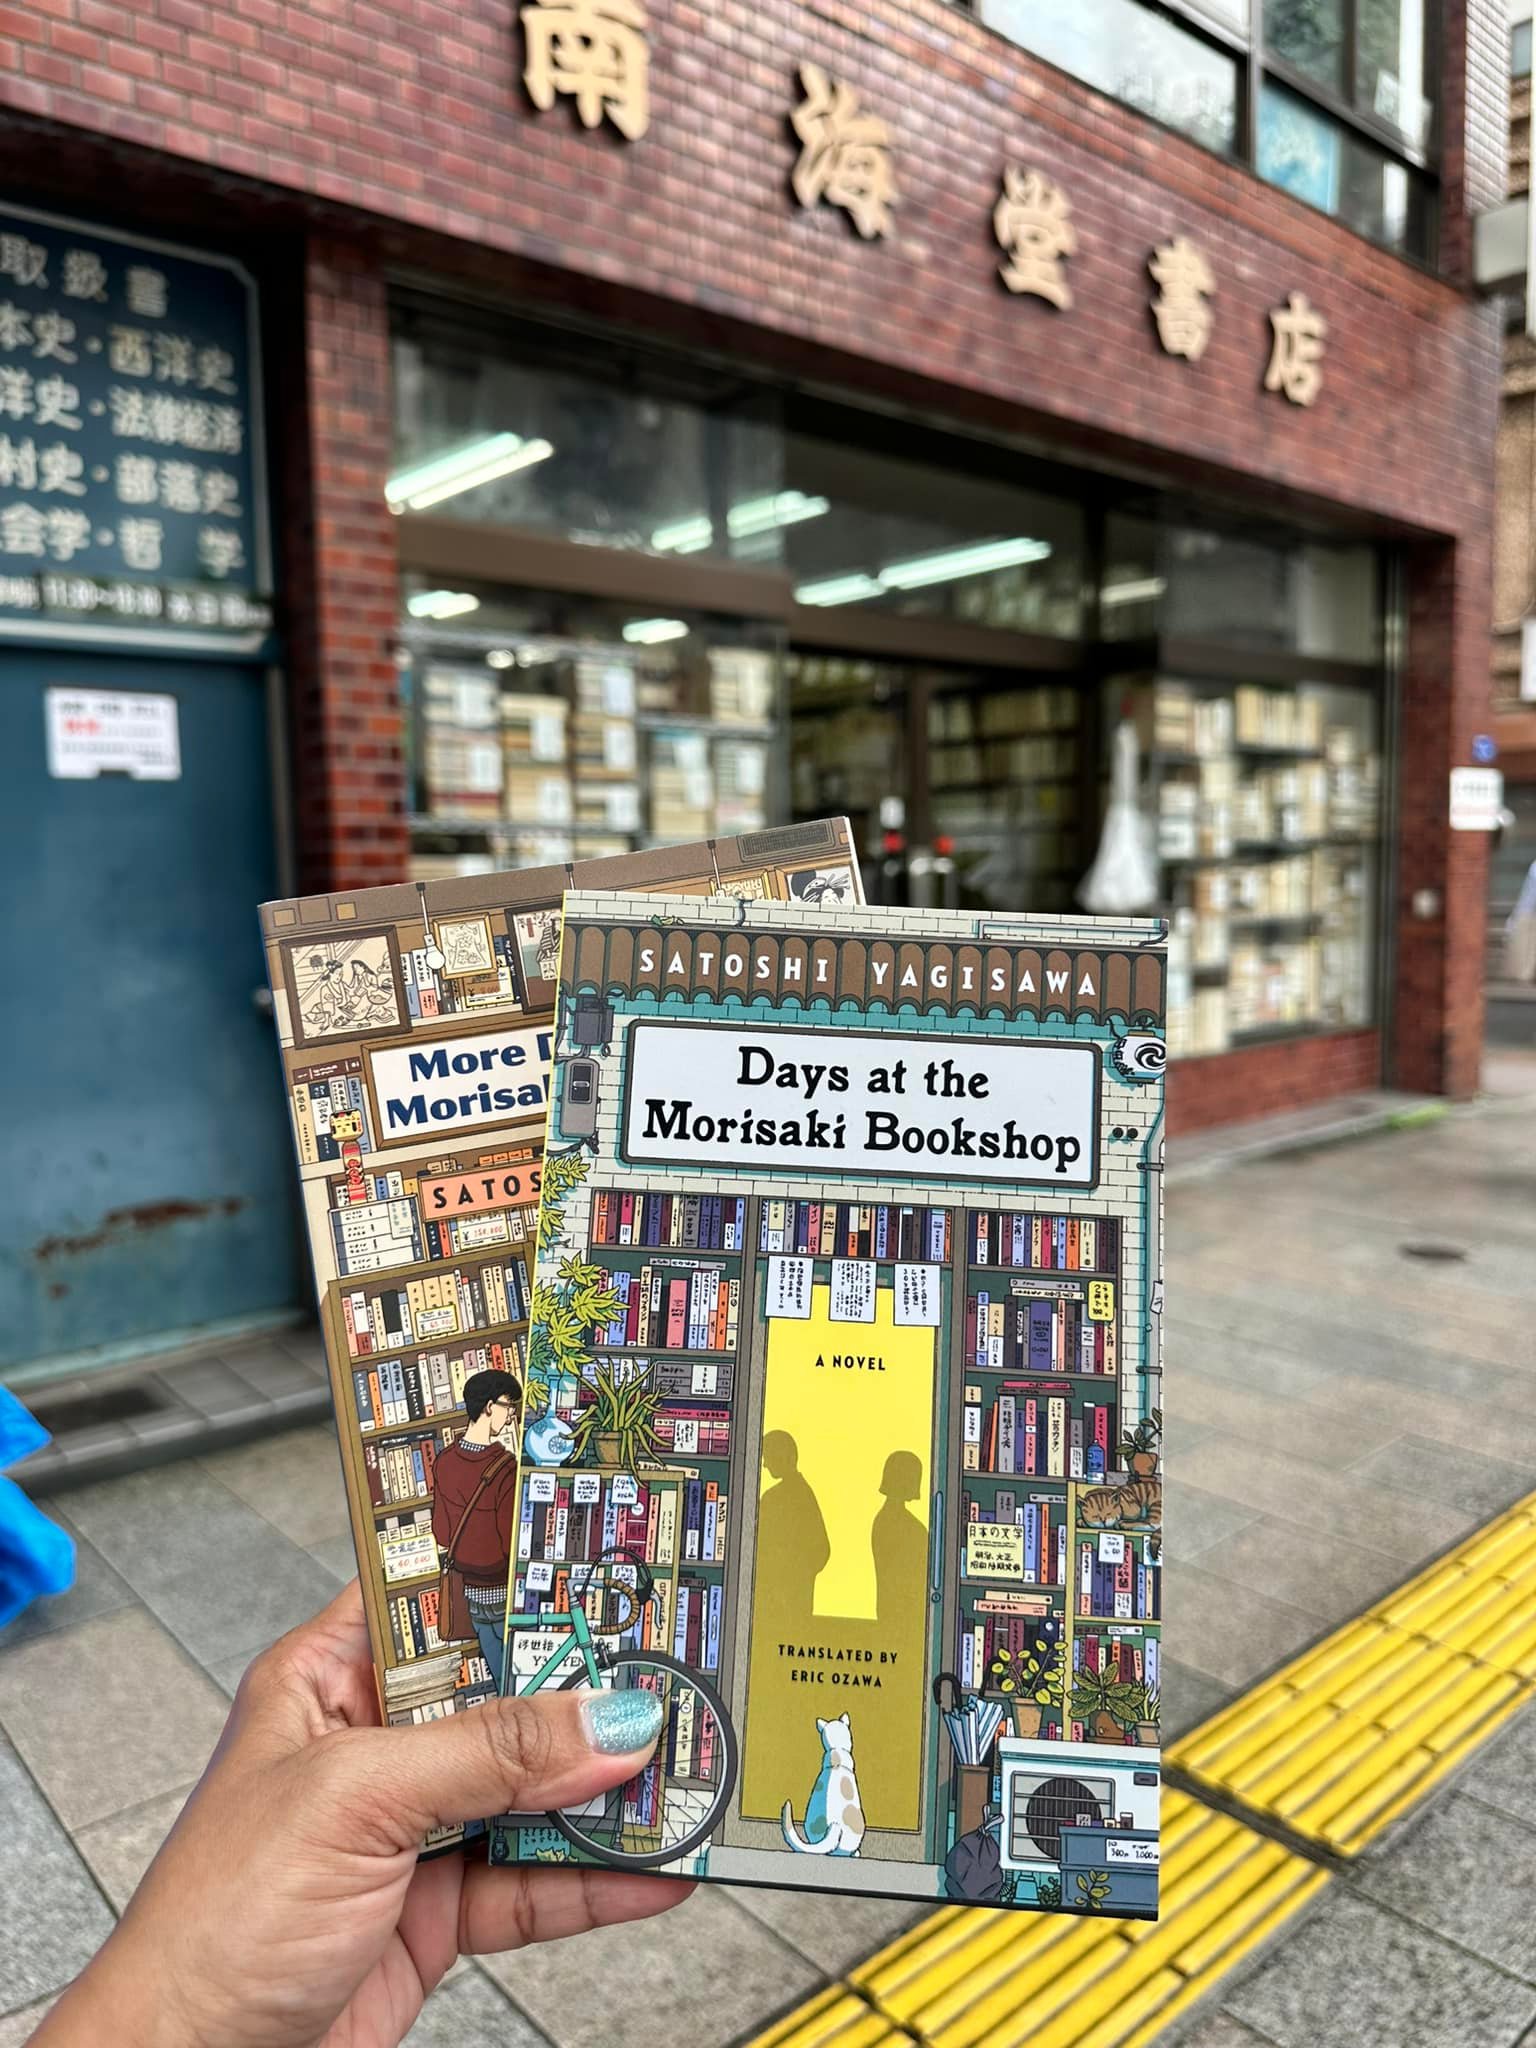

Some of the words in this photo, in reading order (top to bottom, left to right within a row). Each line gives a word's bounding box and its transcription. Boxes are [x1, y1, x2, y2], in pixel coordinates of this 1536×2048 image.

[639, 949, 829, 983] SATOSHI
[872, 961, 1096, 997] YAGISAWA
[408, 1043, 526, 1083] More
[737, 1045, 849, 1099] Days
[867, 1059, 907, 1095] at
[924, 1059, 990, 1099] the
[642, 1099, 846, 1150] Morisaki
[864, 1111, 1081, 1172] Bookshop
[815, 1354, 825, 1368] A
[833, 1355, 886, 1371] NOVEL
[969, 1525, 1022, 1540] 日本の文学
[778, 1644, 873, 1662] TRANSLATED
[880, 1652, 898, 1664] BY
[791, 1669, 824, 1684] ERIC
[831, 1672, 882, 1688] OZAWA
